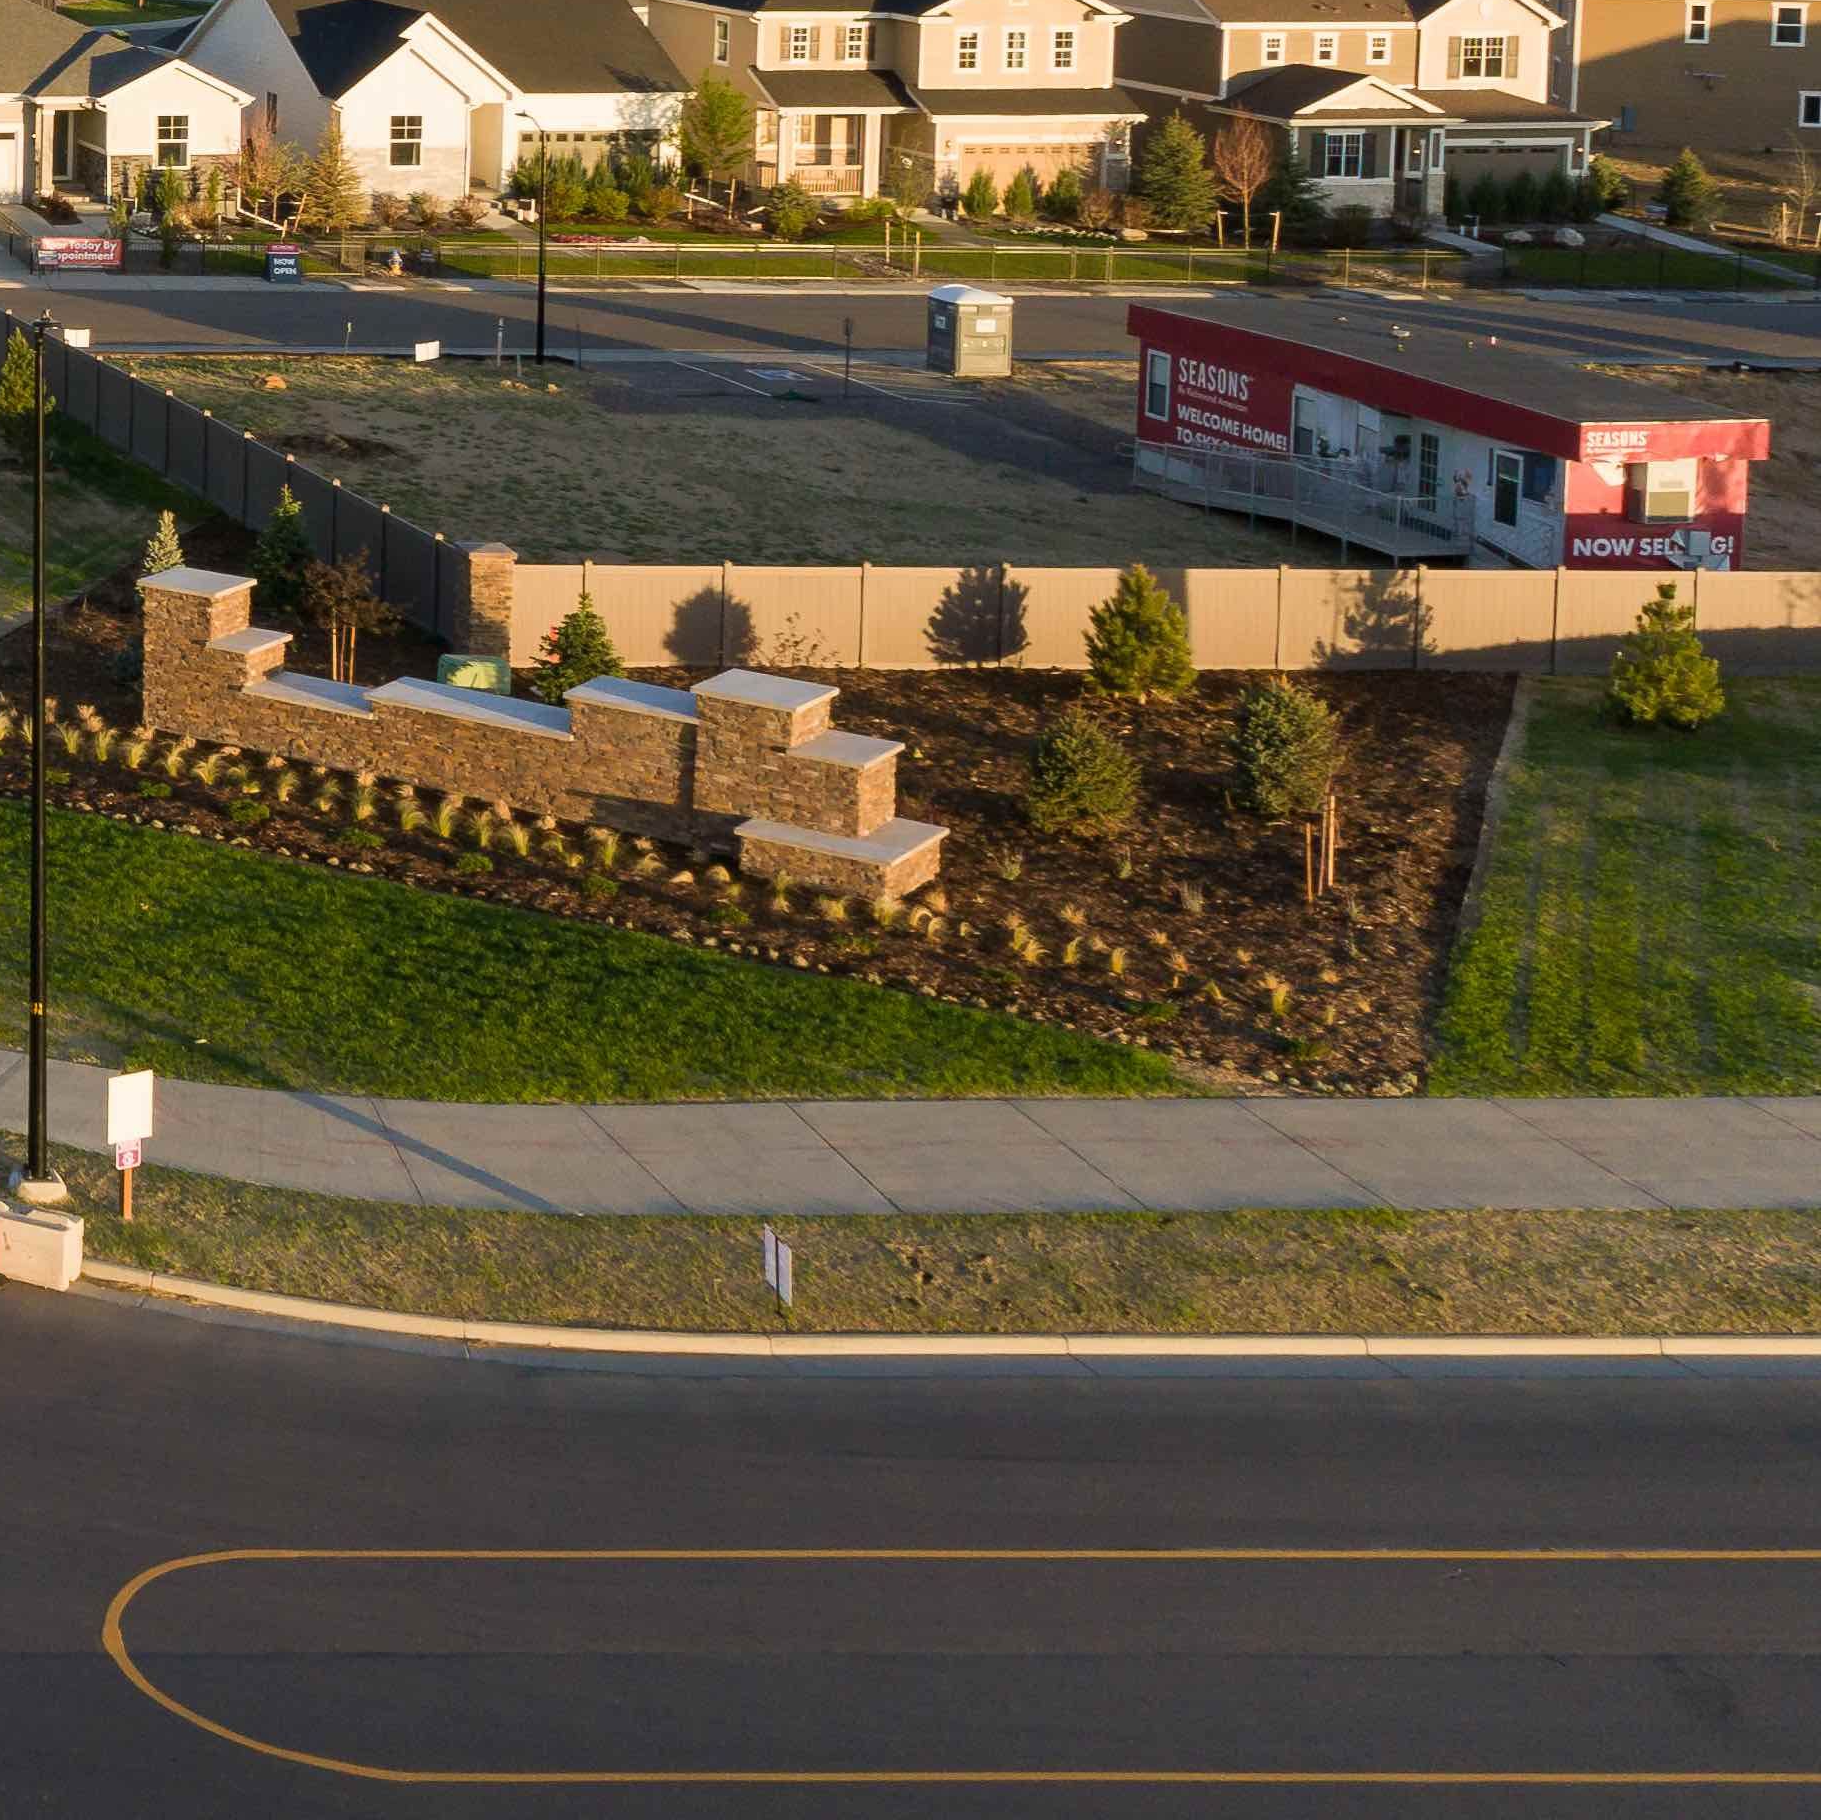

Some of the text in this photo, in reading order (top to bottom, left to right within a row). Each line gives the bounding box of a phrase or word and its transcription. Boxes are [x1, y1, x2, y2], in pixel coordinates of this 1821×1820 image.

[69, 240, 101, 252] Today
[103, 240, 117, 252] By
[56, 252, 114, 262] pointment
[1178, 357, 1250, 401] SEASONS
[1175, 426, 1193, 444] TO
[1176, 403, 1241, 437] WELCOME
[1242, 423, 1288, 452] HOME!
[1586, 431, 1647, 447] SEASONS
[1573, 535, 1734, 557] NOW SELG!
